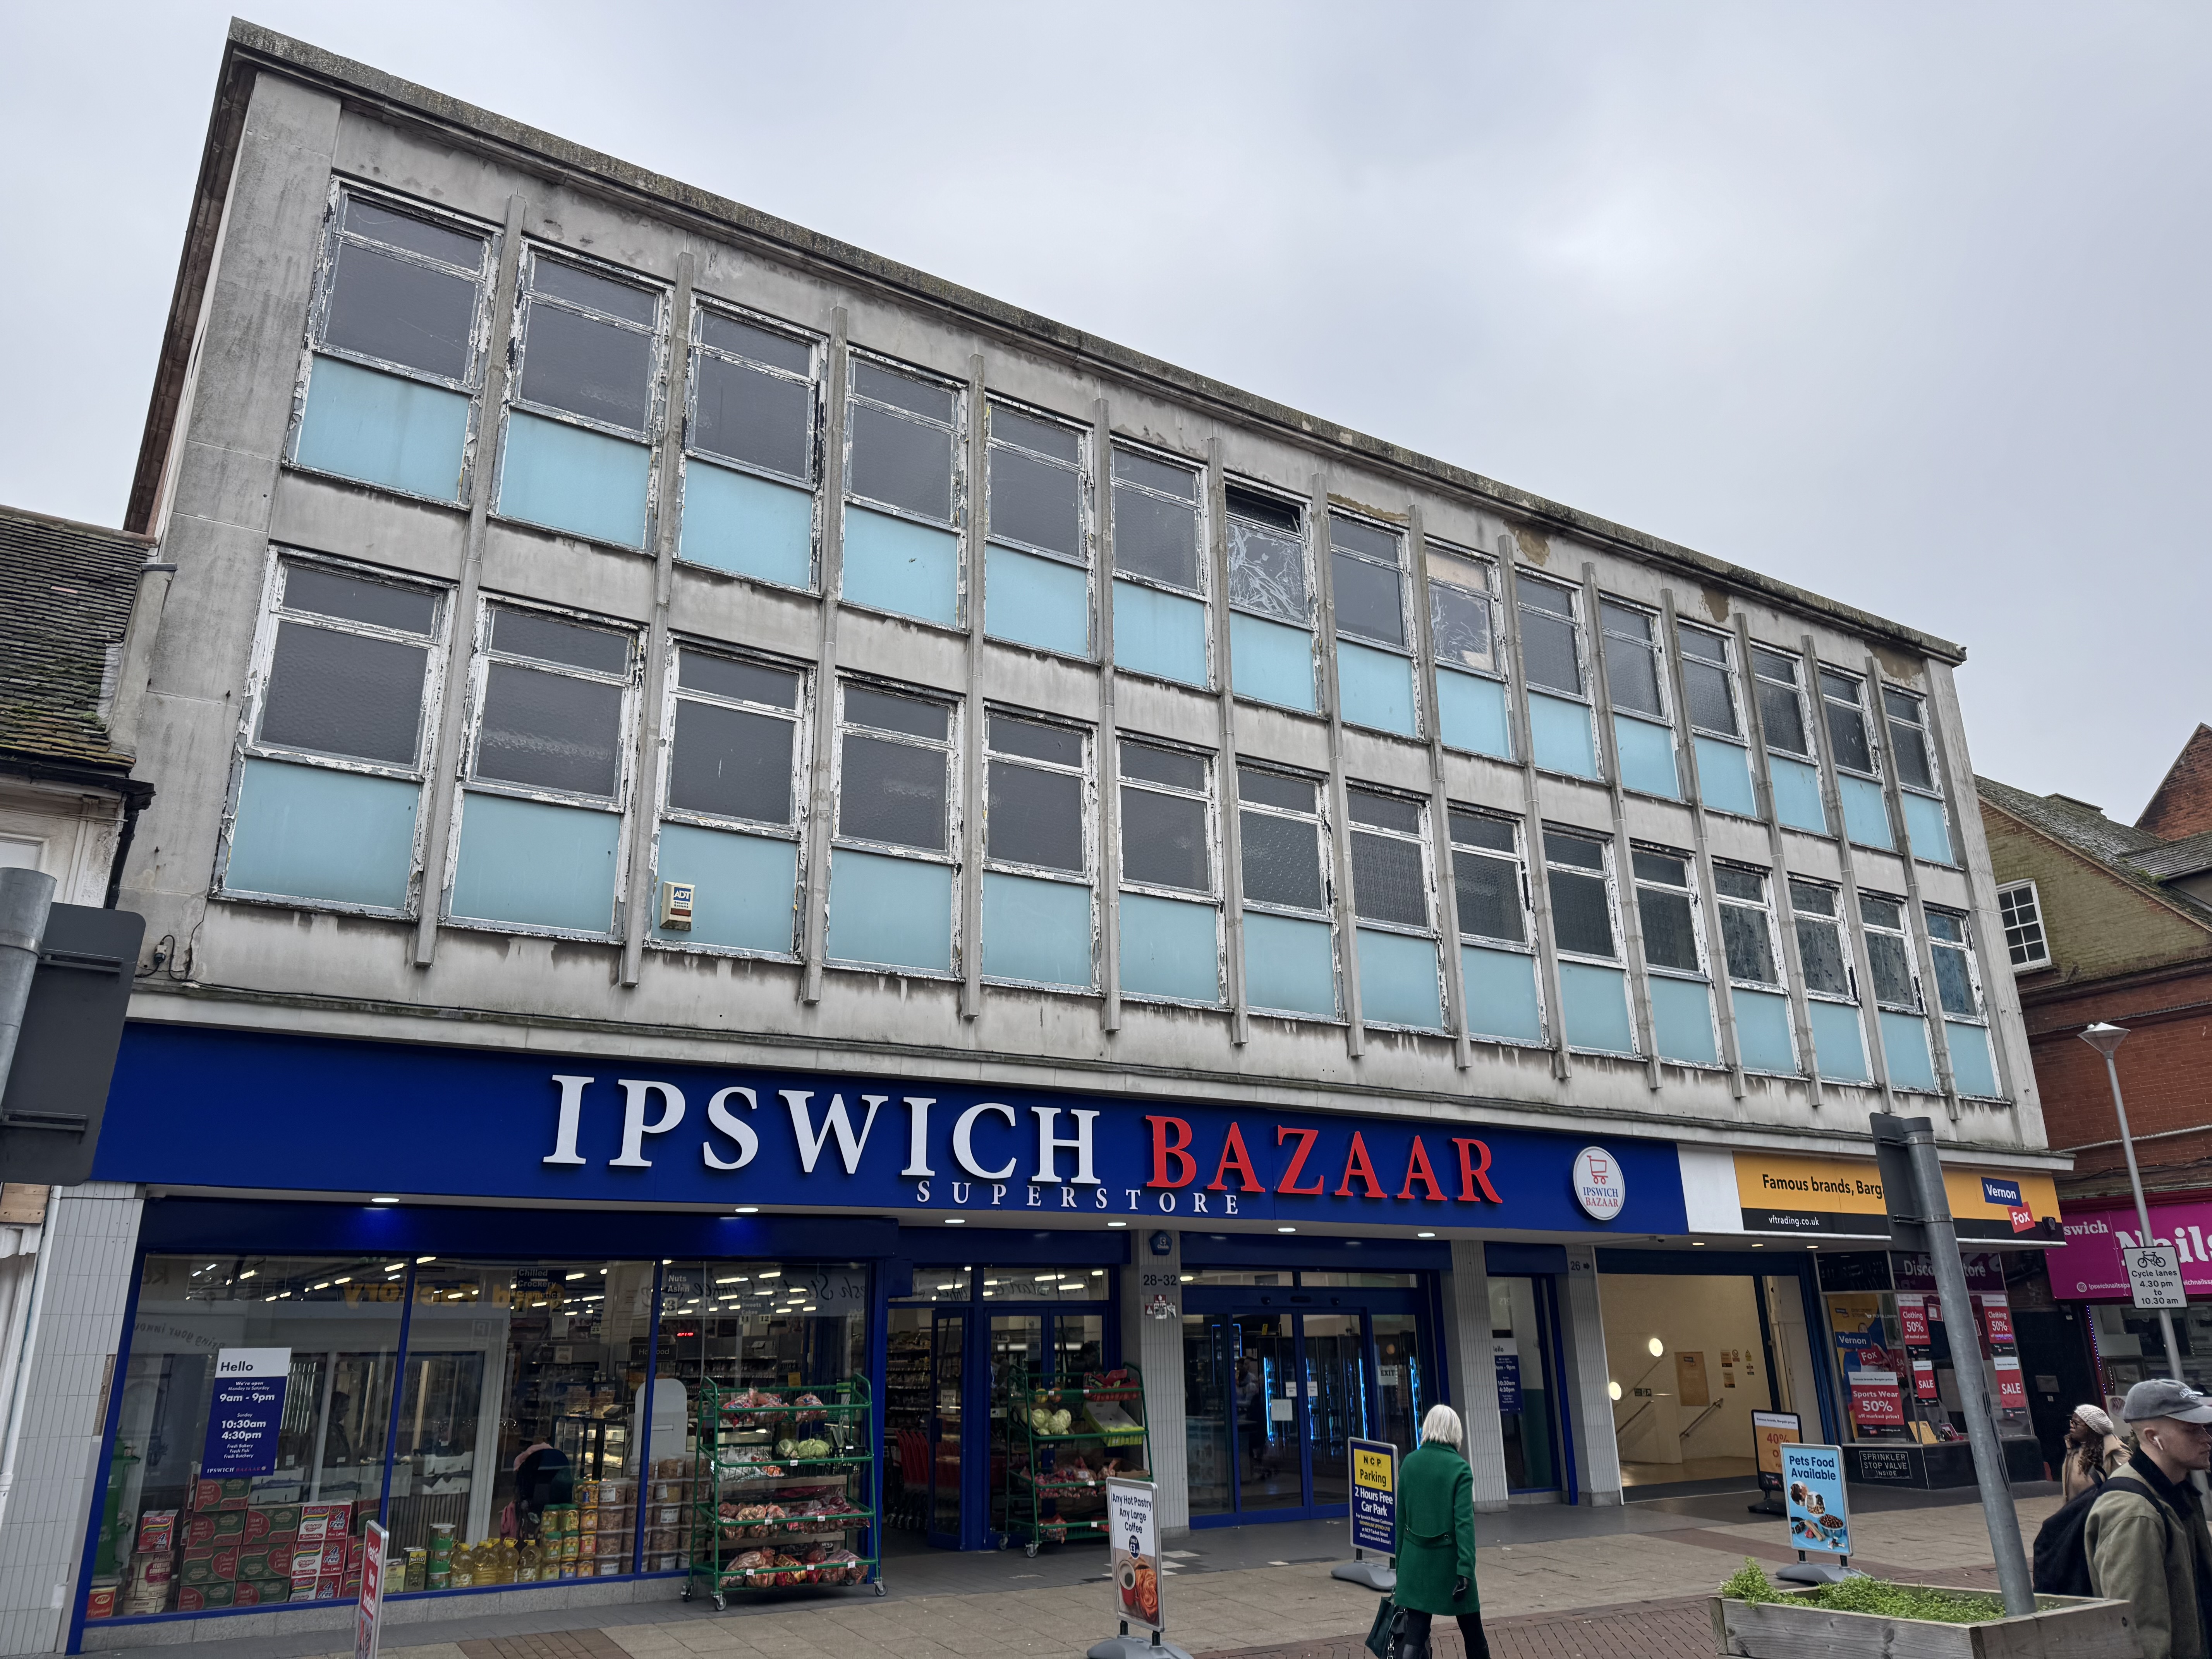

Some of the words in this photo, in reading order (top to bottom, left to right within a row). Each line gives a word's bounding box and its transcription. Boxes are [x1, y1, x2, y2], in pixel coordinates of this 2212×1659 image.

[674, 890, 690, 899] ADT
[543, 1074, 1101, 1185] IPSWICH
[1146, 1115, 1503, 1203] BAZAAR
[1583, 1187, 1619, 1197] IPSWICH
[1762, 1174, 1809, 1191] Famous
[1811, 1176, 1854, 1196] brands,
[1856, 1180, 1883, 1199] Barg
[1985, 1183, 2017, 1199] Vernon
[917, 1180, 1238, 1215] SUPERSTORE
[1585, 1197, 1619, 1207] BAZAAR
[1769, 1215, 1819, 1227] vftrading.co.uk
[2012, 1212, 2030, 1225] Fox
[2063, 1220, 2109, 1235] swich
[1570, 1261, 1580, 1271] 26
[1903, 1260, 1935, 1277] Disco
[1963, 1261, 1986, 1277] tore
[518, 1280, 556, 1288] Crockery
[1143, 1274, 1177, 1286] 28-32
[667, 1300, 676, 1311] 3
[1903, 1311, 1923, 1320] Clothing
[1988, 1312, 2007, 1320] Clothing
[1906, 1321, 1924, 1332] 50%
[1992, 1321, 2008, 1331] 50%
[1839, 1335, 1867, 1345] Vernon
[1861, 1352, 1877, 1361] Fox
[220, 1361, 253, 1371] Hello
[1918, 1380, 1934, 1389] SALE
[2001, 1383, 2021, 1395] SALE
[220, 1393, 243, 1402] 9am
[252, 1393, 275, 1403] 9pm
[1853, 1391, 1877, 1399] Sports
[1862, 1400, 1893, 1412] 50%
[222, 1420, 266, 1429] 10:30am
[221, 1431, 262, 1441] 4:30pm
[1767, 1433, 1790, 1444] 40%
[1363, 1455, 1381, 1467] NCP
[1789, 1455, 1810, 1466] Pets
[1811, 1456, 1834, 1468] Food
[1360, 1469, 1386, 1487] Parking
[1791, 1468, 1836, 1480] Available
[1355, 1486, 1359, 1497] 2
[1360, 1487, 1378, 1501] Hours
[1379, 1492, 1393, 1505] Free
[1113, 1493, 1123, 1507] Any
[1123, 1495, 1133, 1505] Hot
[1134, 1496, 1152, 1511] Pastry
[1361, 1501, 1372, 1513] Car
[1373, 1503, 1388, 1517] Park
[1120, 1507, 1130, 1522] Any
[1131, 1509, 1146, 1524] Large
[1125, 1522, 1142, 1534] Coffee
